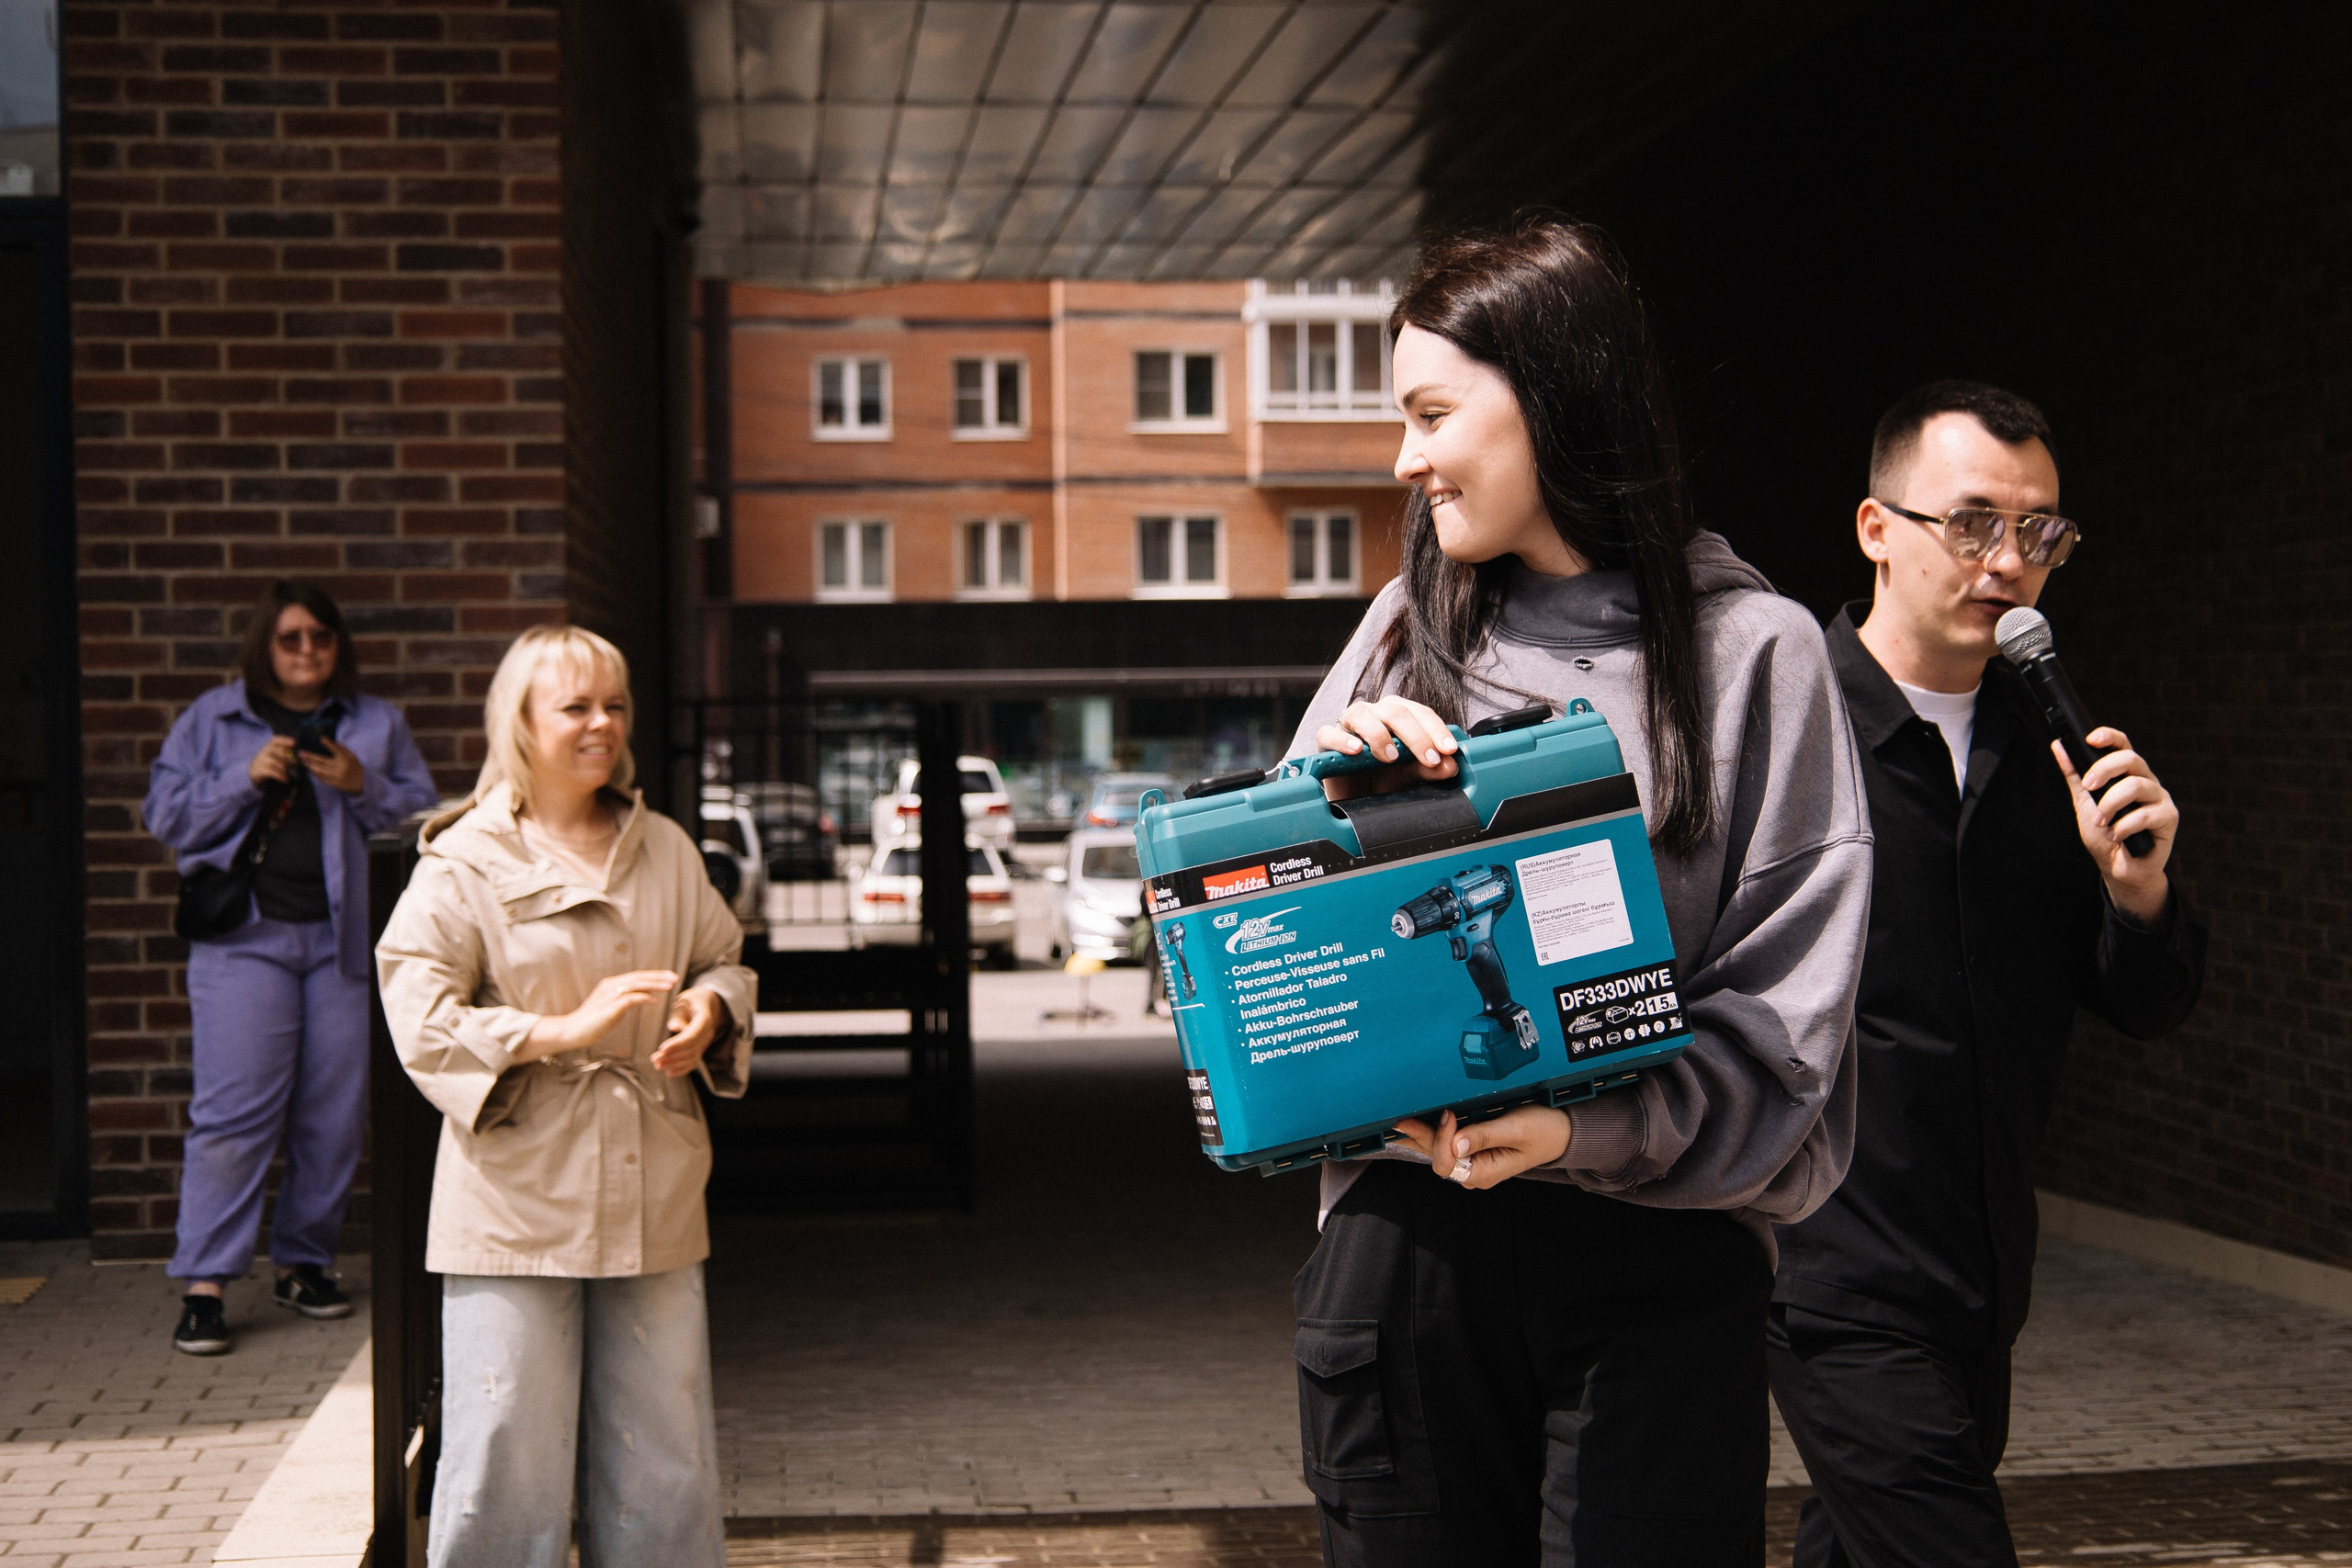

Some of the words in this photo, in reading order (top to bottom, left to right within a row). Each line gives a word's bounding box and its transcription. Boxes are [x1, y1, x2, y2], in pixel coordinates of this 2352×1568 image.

[1270, 857, 1312, 873] Cordless
[1272, 872, 1302, 886] Driver
[1303, 865, 1324, 879] Drill
[1213, 912, 1238, 929] CXT
[1240, 931, 1296, 953] LITHIUM-ION
[1231, 957, 1283, 976] Cordless
[1283, 949, 1317, 965] Driver
[1320, 942, 1344, 956] Drill
[1234, 960, 1340, 991] Perceuse-Visseuse
[1342, 953, 1369, 966] sans
[1370, 948, 1385, 960] Fil
[1238, 983, 1304, 1006] Atornillador
[1306, 973, 1348, 989] Taladro
[1560, 968, 1673, 1010] DF333DWYE
[1240, 998, 1306, 1020] Inalámbrico
[1245, 999, 1359, 1034] Akku-Bohrschrauber
[1249, 1018, 1347, 1048] Аккумуляторная
[1250, 1030, 1360, 1065] Дрель-шуруповерт
